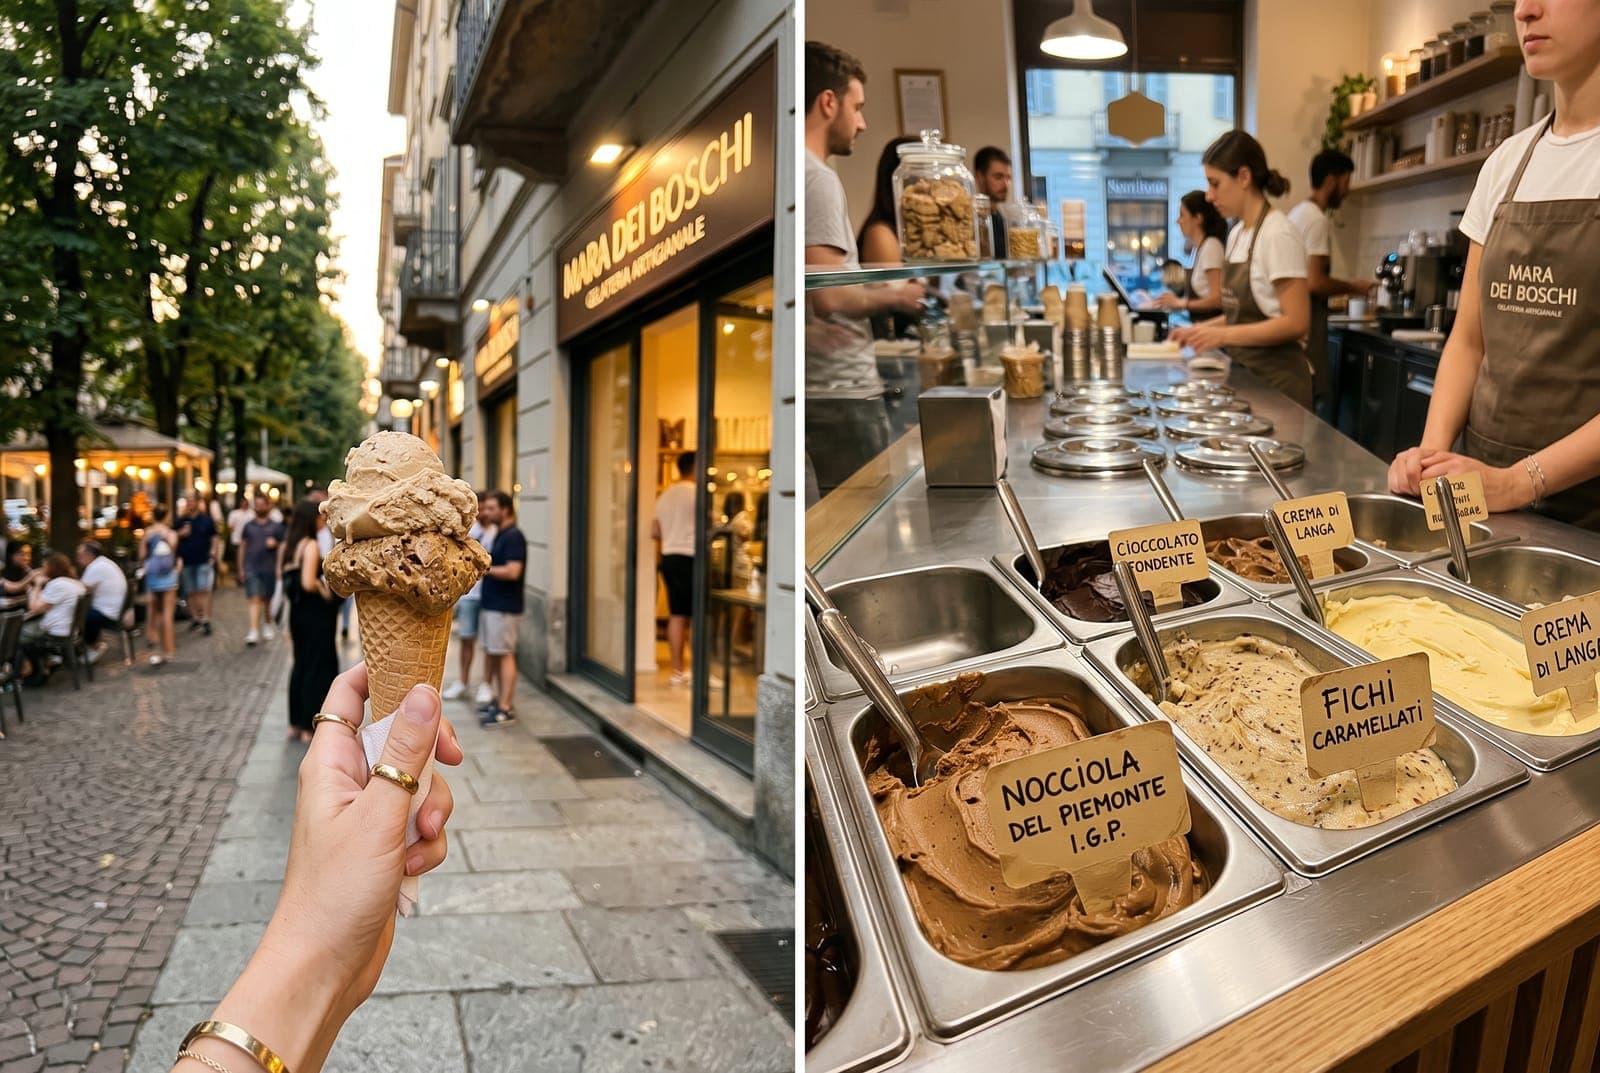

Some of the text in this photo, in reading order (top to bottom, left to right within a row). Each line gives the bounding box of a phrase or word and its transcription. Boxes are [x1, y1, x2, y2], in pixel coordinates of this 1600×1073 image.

[563, 111, 752, 299] MARA DEI BOSCHI
[1508, 264, 1554, 284] MARA
[1490, 282, 1577, 306] DEI BOSCHI
[1283, 506, 1324, 524] CREMA
[1295, 522, 1335, 540] LANGA
[1534, 611, 1592, 646] CREMA
[1536, 661, 1550, 678] DI
[1008, 775, 1166, 843] DEL PIEMONTE
[1070, 819, 1126, 854] I.G.P.
